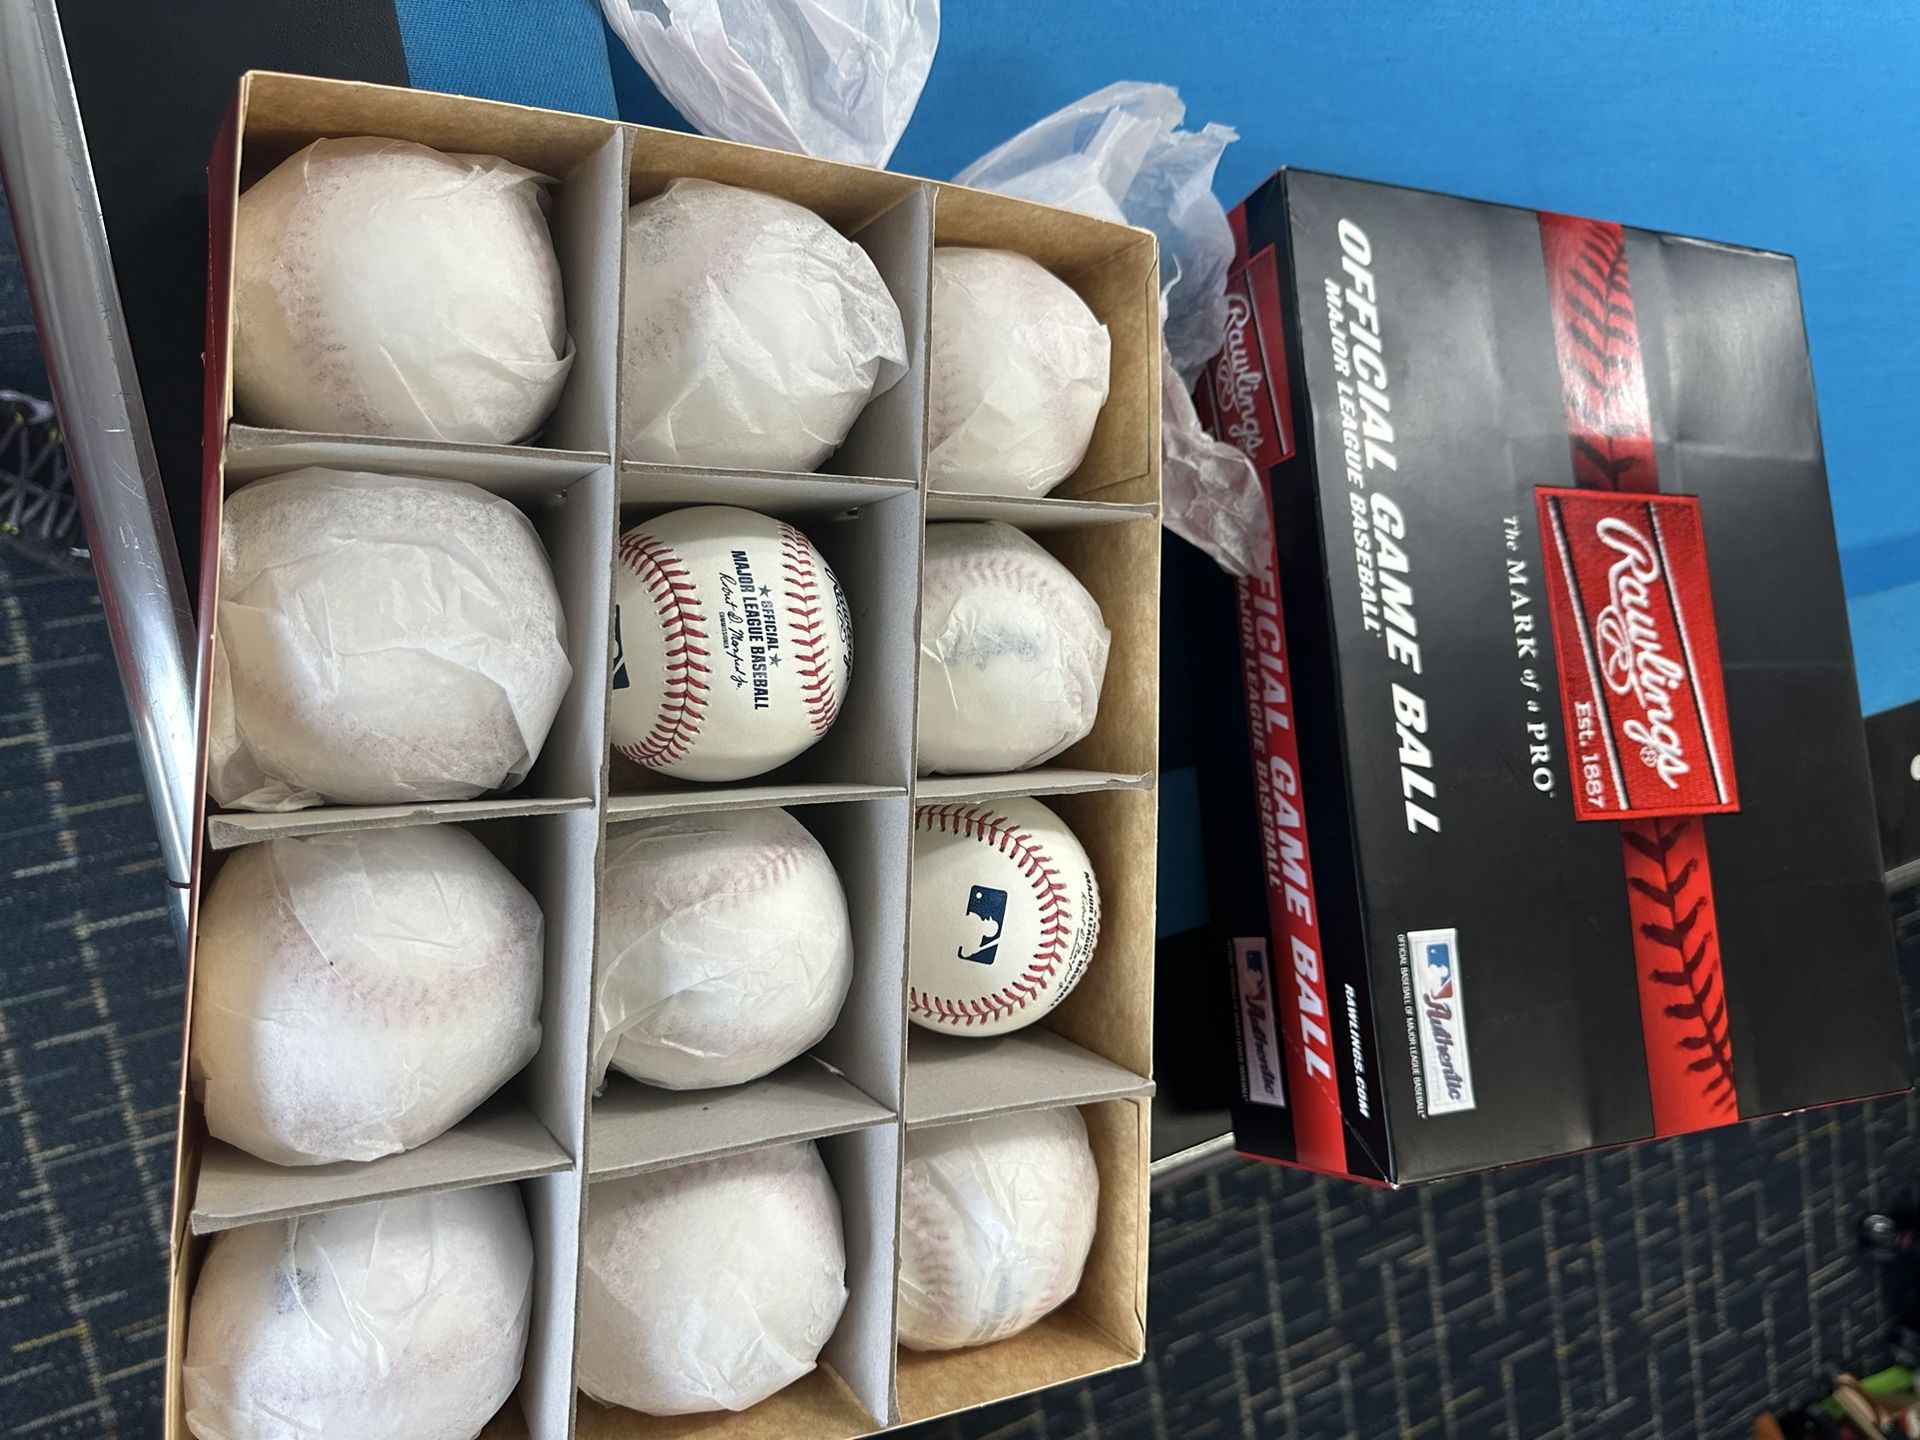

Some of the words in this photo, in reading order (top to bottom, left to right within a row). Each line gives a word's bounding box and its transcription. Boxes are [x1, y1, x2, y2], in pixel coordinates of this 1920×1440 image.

[1324, 277, 1350, 377] MAJOR
[1338, 217, 1397, 471] OFFICIAL
[1221, 293, 1264, 458] Rawlings
[1337, 382, 1364, 489] LEAGUE
[1349, 492, 1380, 632] BASEBALL
[1502, 515, 1522, 551] The
[730, 550, 755, 593] MAJOR
[1370, 492, 1423, 675] GAME
[743, 596, 763, 642] LEAGUE
[761, 600, 779, 651] OFFICIAL
[1506, 558, 1537, 659] MARK
[750, 646, 769, 710] BASEBALL
[1253, 562, 1289, 735] FICIAL
[1520, 668, 1542, 692] of
[1596, 516, 1691, 790] Rawlings
[1526, 700, 1541, 713] a
[1574, 700, 1597, 747] Est.
[1246, 658, 1265, 755] LEAGUE
[1256, 760, 1281, 887] BASEBALL
[1391, 682, 1441, 834] BALL
[1527, 721, 1555, 792] PRO
[1581, 752, 1605, 809] 1887
[1269, 755, 1312, 927] GAME
[1084, 871, 1094, 914] MAJOR
[1081, 917, 1093, 956] LEAGUE
[1397, 934, 1407, 966] OFFICIAL
[1290, 935, 1331, 1080] BALL
[1400, 967, 1412, 1005] BASEBALL
[1404, 1005, 1413, 1017] OF
[1345, 983, 1371, 1120] RAWLINGS.COM
[1405, 1017, 1417, 1047] MAJOR
[1409, 1047, 1420, 1076] LEAGUE
[1423, 993, 1464, 1102] Authentic
